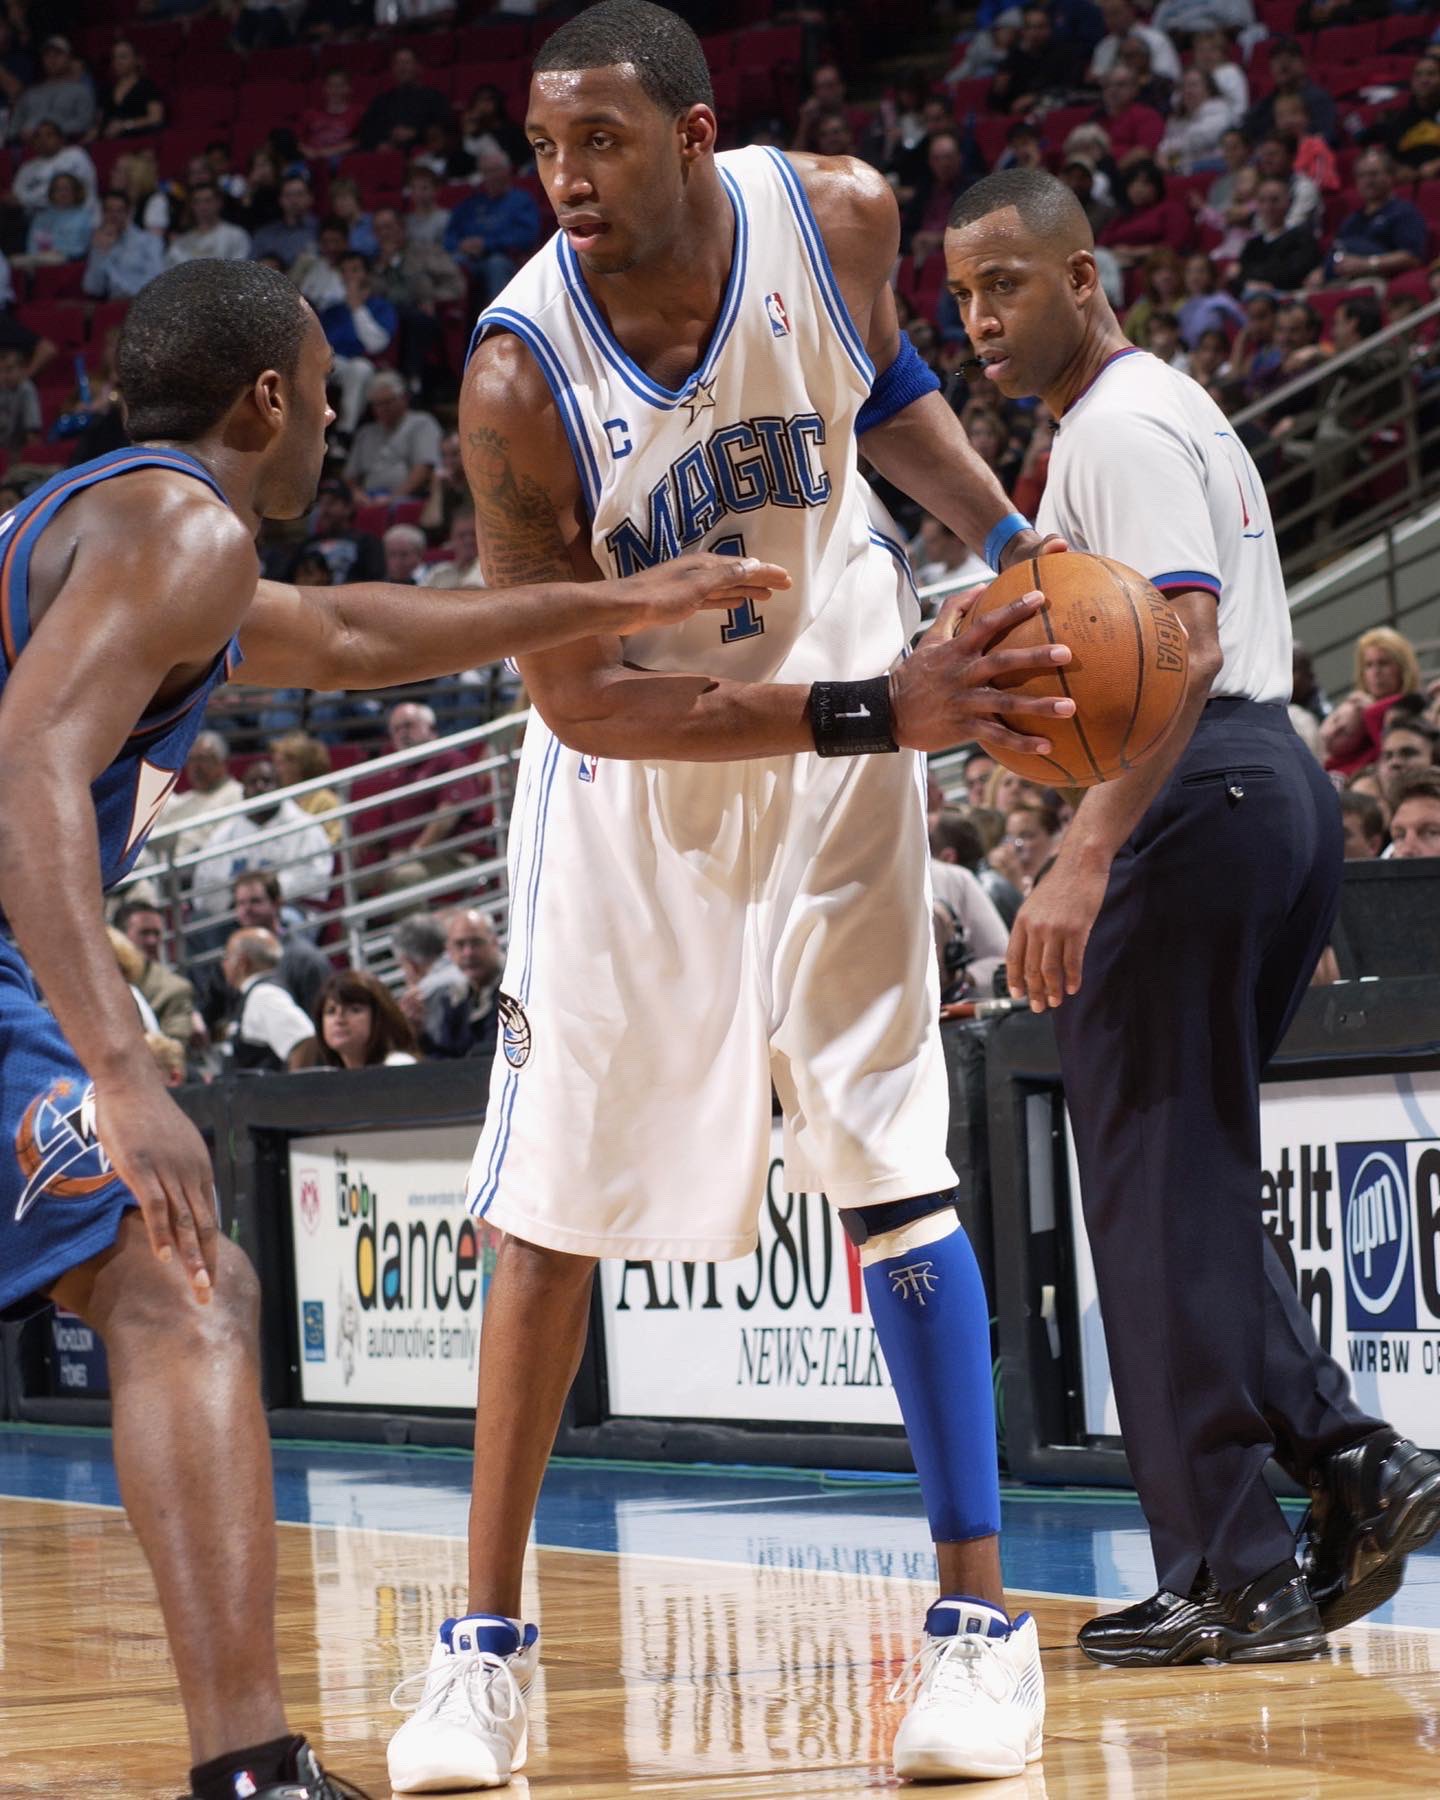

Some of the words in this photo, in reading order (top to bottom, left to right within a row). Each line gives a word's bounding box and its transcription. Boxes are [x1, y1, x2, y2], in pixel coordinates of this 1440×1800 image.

[602, 417, 632, 460] C
[606, 412, 832, 579] MAGIC
[708, 533, 764, 644] 1
[356, 1193, 478, 1311] dance
[1352, 1174, 1397, 1279] upn
[1347, 1340, 1410, 1373] WRBW
[1423, 1340, 1440, 1375] O
